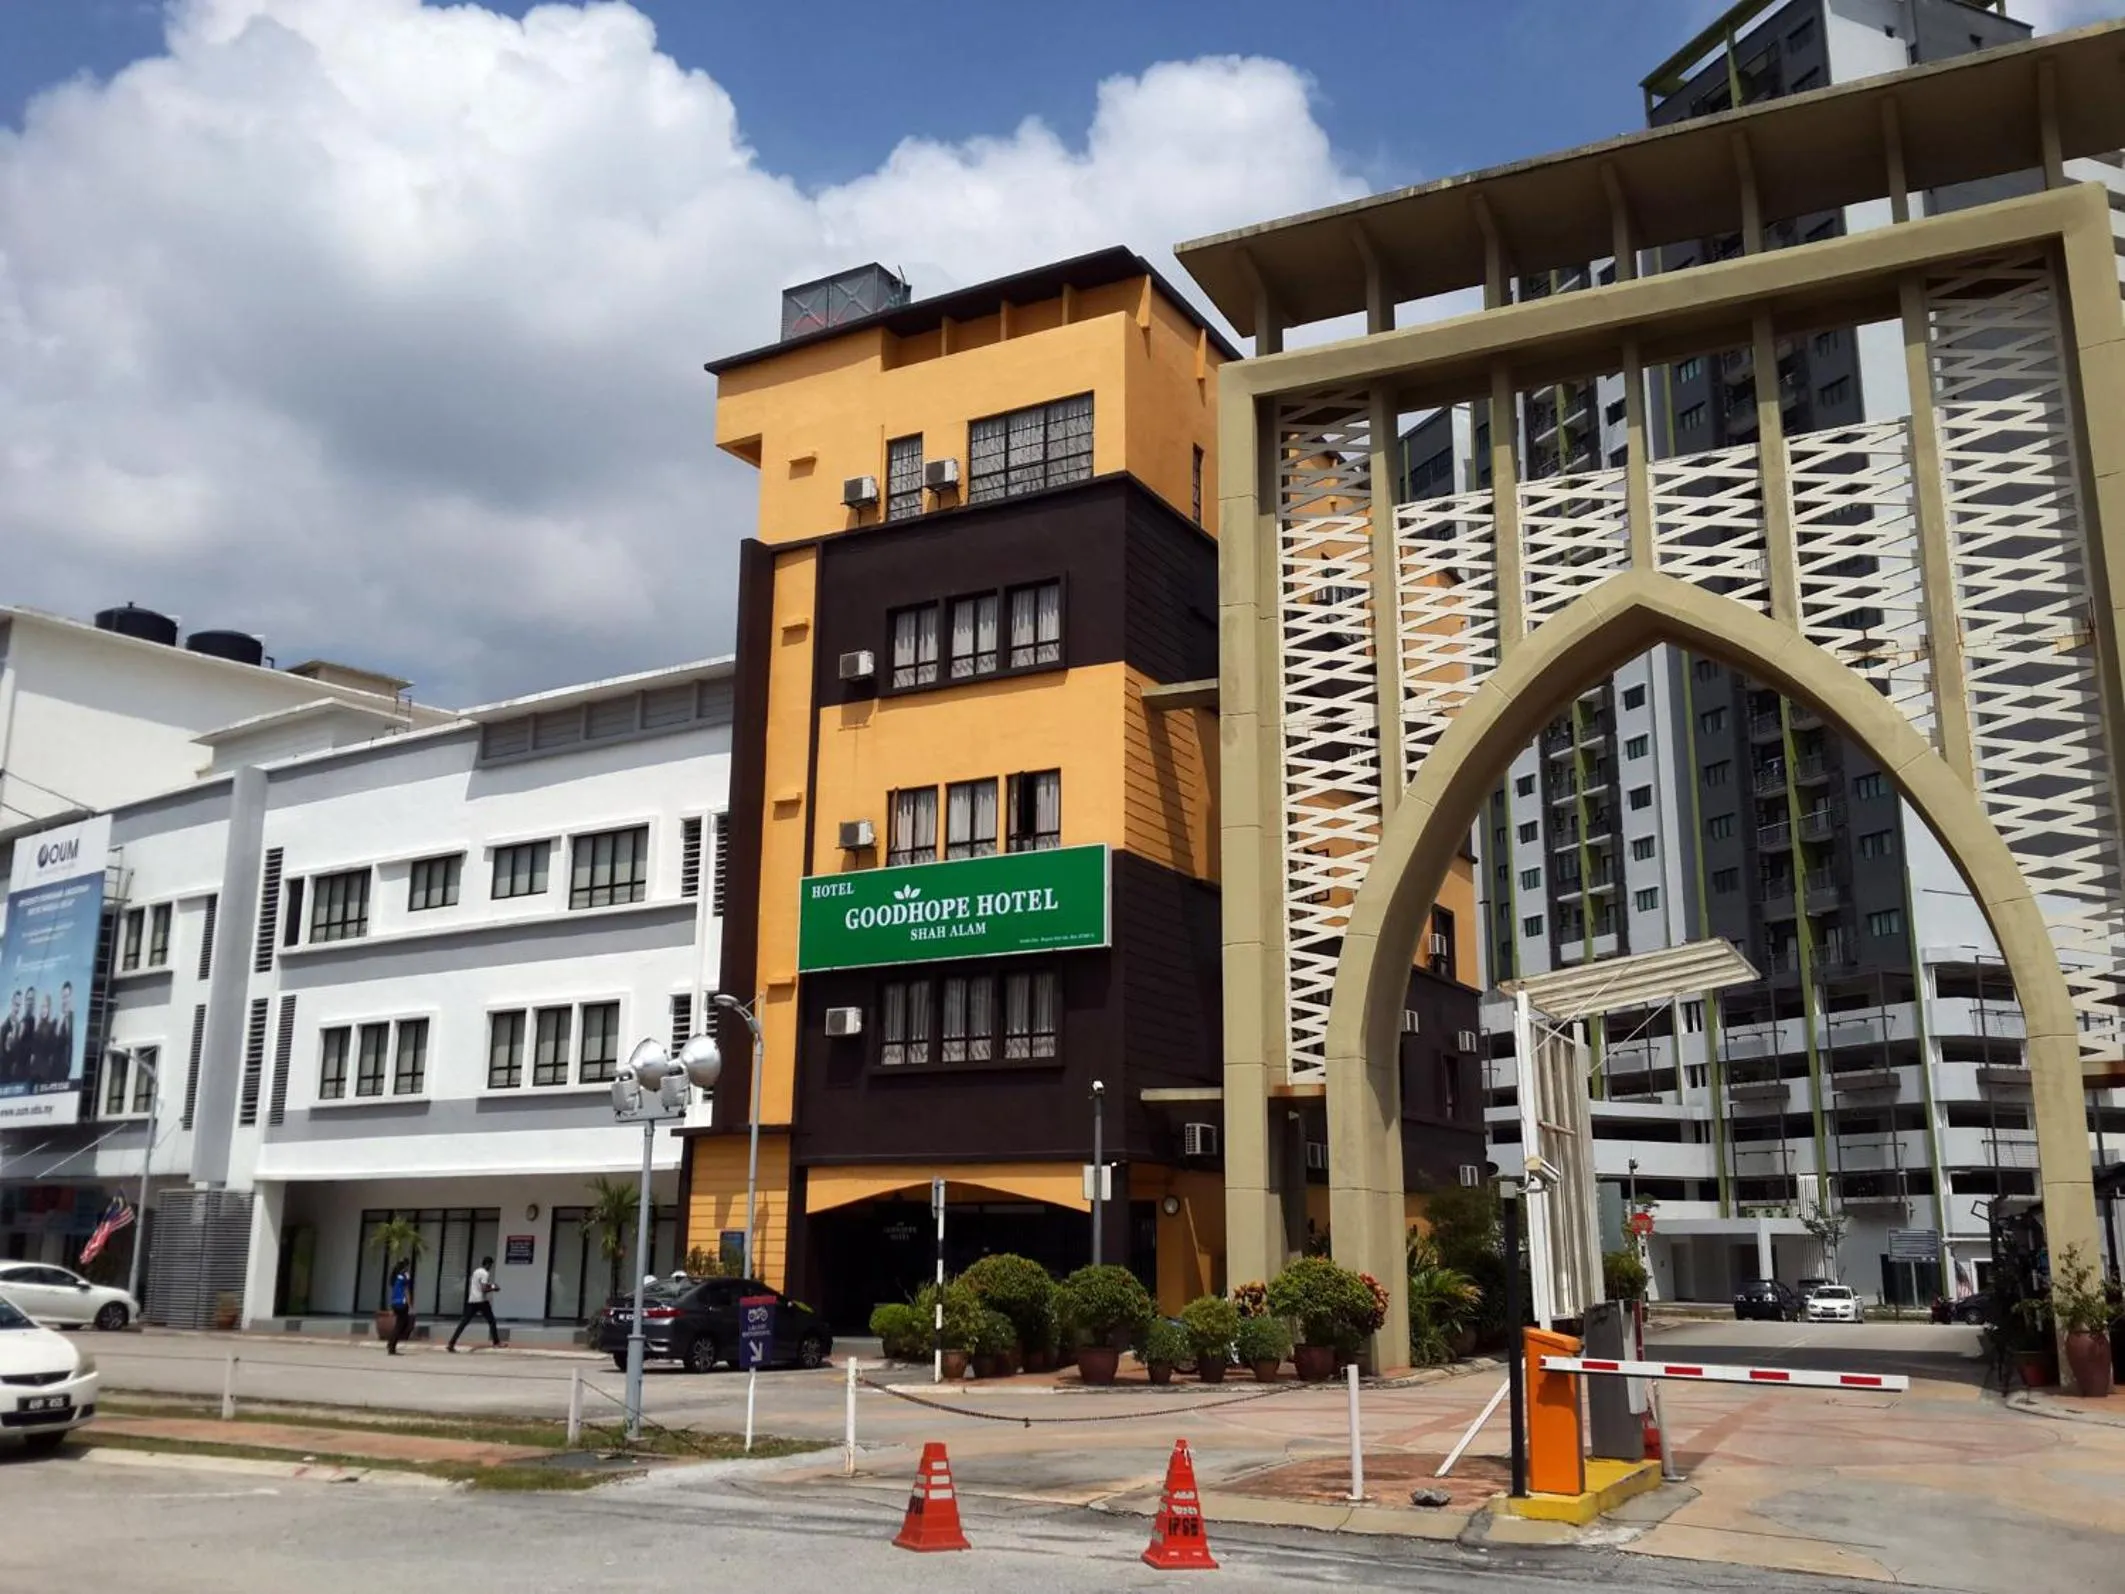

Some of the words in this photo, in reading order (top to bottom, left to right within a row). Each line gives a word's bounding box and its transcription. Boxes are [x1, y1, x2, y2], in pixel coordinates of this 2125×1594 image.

[49, 838, 79, 864] OUM
[811, 882, 855, 898] HOTEL
[845, 897, 970, 930] GOODHOPE
[976, 888, 1059, 917] HOTEL
[910, 926, 946, 941] SHAH
[950, 922, 987, 937] ALAM
